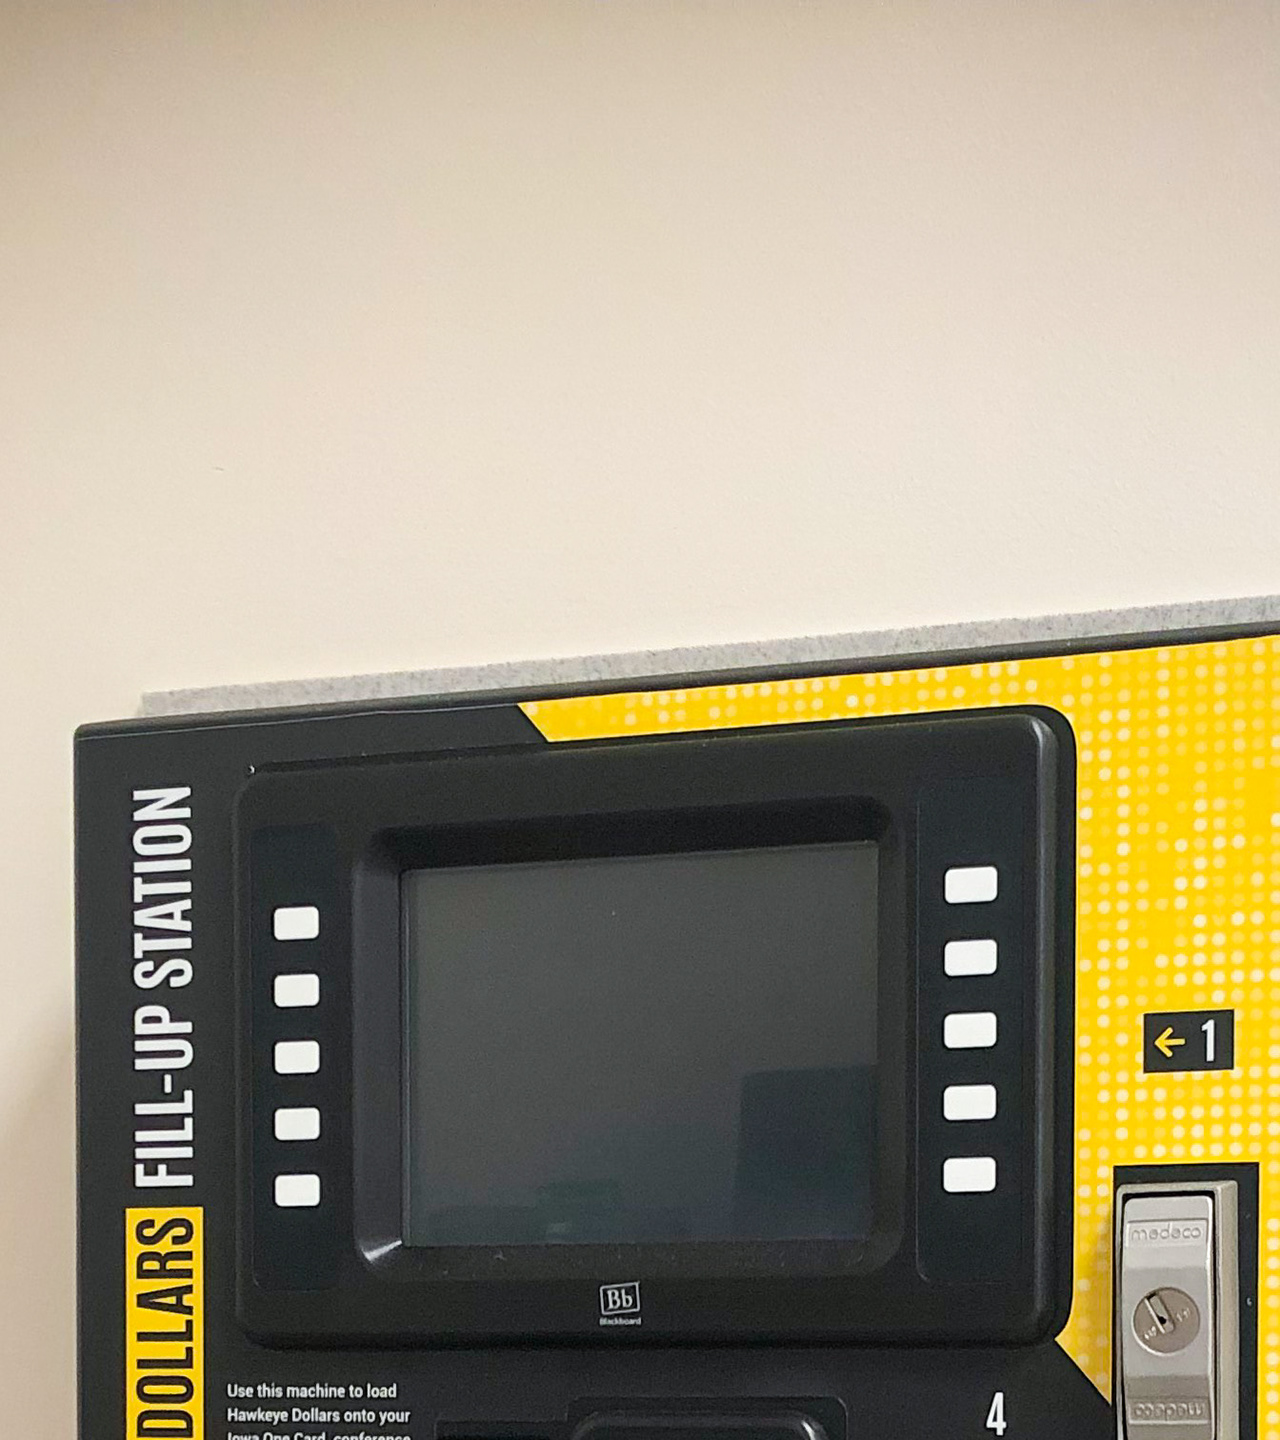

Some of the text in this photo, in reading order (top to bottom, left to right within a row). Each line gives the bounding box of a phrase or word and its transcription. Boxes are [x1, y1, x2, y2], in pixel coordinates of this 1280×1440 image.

[133, 786, 194, 1188] FILL-UP STATION
[1200, 1019, 1216, 1062] 1
[1132, 1222, 1201, 1240] medeco
[606, 1288, 633, 1310] Bb
[136, 1217, 193, 1438] DOLLARS
[227, 1383, 397, 1398] Use this machine to load
[227, 1407, 411, 1426] Hawkeye Dollars onto your
[986, 1392, 1007, 1436] 4
